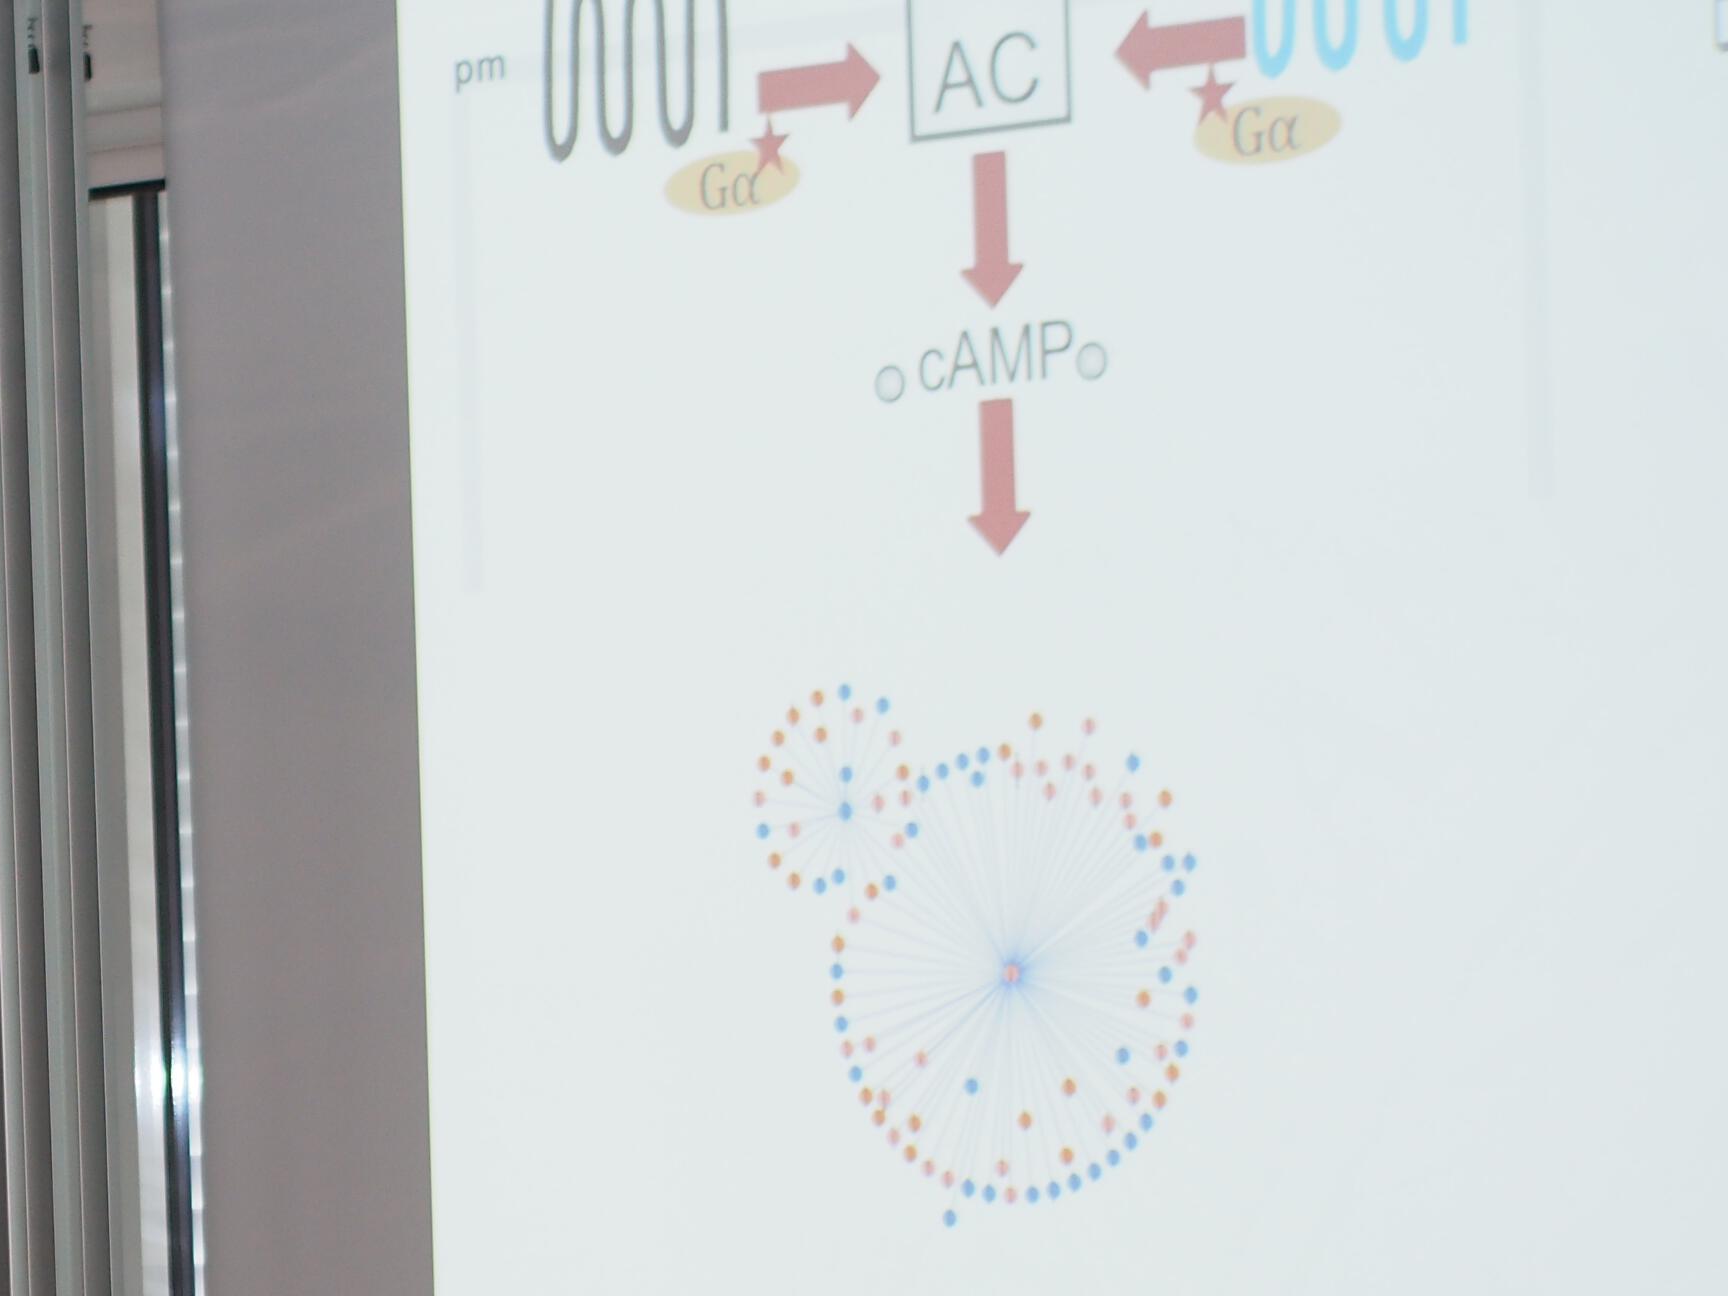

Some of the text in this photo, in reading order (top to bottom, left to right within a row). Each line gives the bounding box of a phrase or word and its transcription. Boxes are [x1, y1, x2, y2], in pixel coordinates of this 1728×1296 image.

[455, 54, 506, 94] pm
[934, 31, 1039, 114] AC
[918, 319, 1074, 392] cAMP
